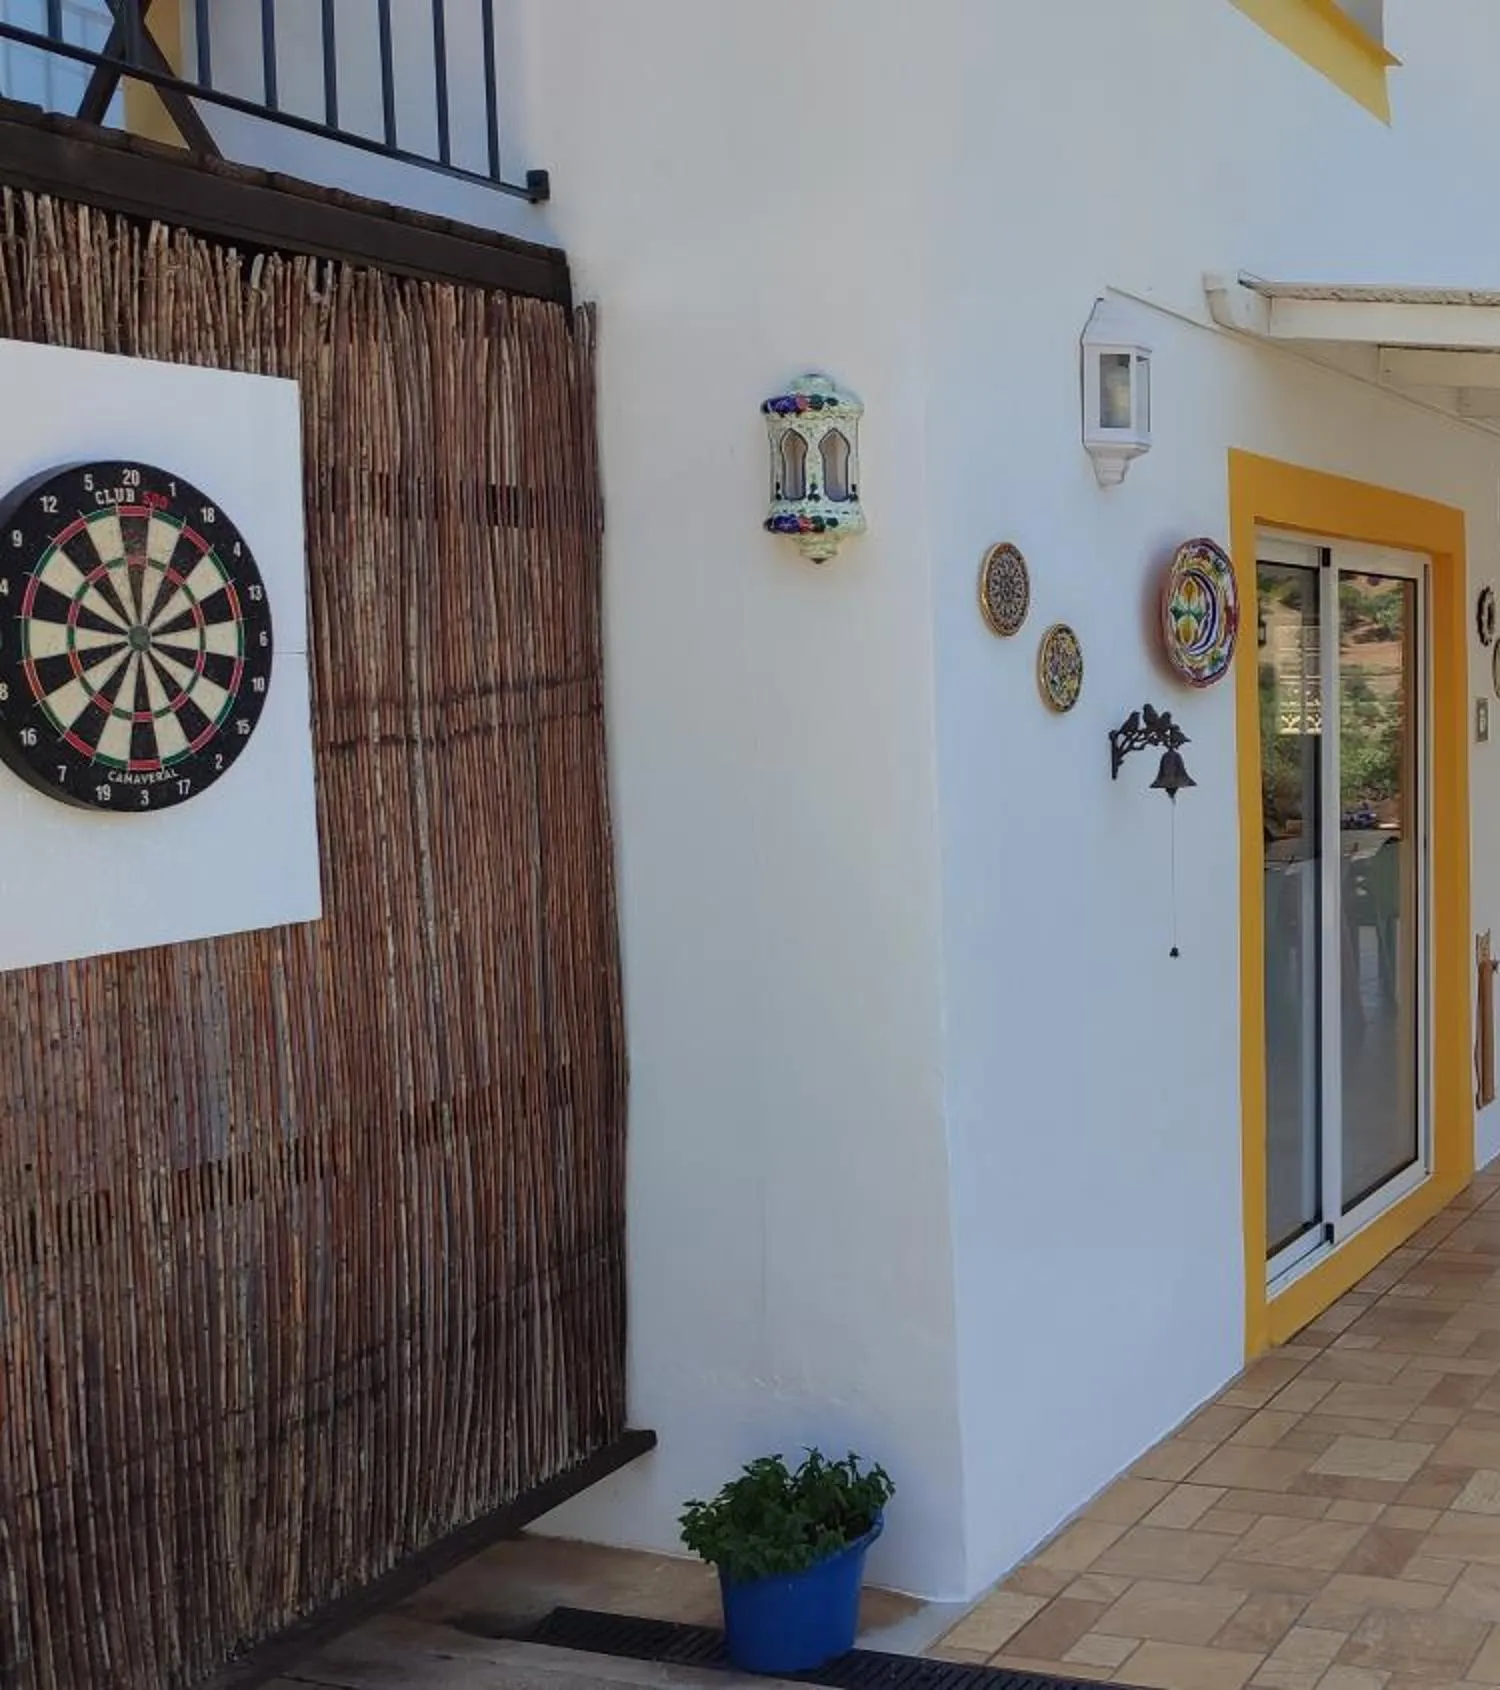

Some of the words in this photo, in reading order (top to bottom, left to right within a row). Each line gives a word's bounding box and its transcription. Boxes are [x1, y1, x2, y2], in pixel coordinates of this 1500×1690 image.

[83, 473, 94, 491] 5
[122, 468, 140, 487] 20
[95, 486, 135, 505] CLUB
[168, 481, 177, 497] 1
[40, 495, 59, 513] 12
[201, 506, 215, 523] 18
[12, 529, 23, 548] 9
[233, 541, 241, 557] 4
[248, 585, 263, 601] 13
[259, 631, 268, 647] 6
[251, 676, 265, 692] 10
[235, 719, 250, 735] 15
[20, 727, 37, 746] 16
[215, 753, 223, 769] 2
[57, 765, 67, 782] 7
[95, 783, 111, 801] 19
[178, 779, 191, 795] 17
[140, 789, 149, 806] 3
